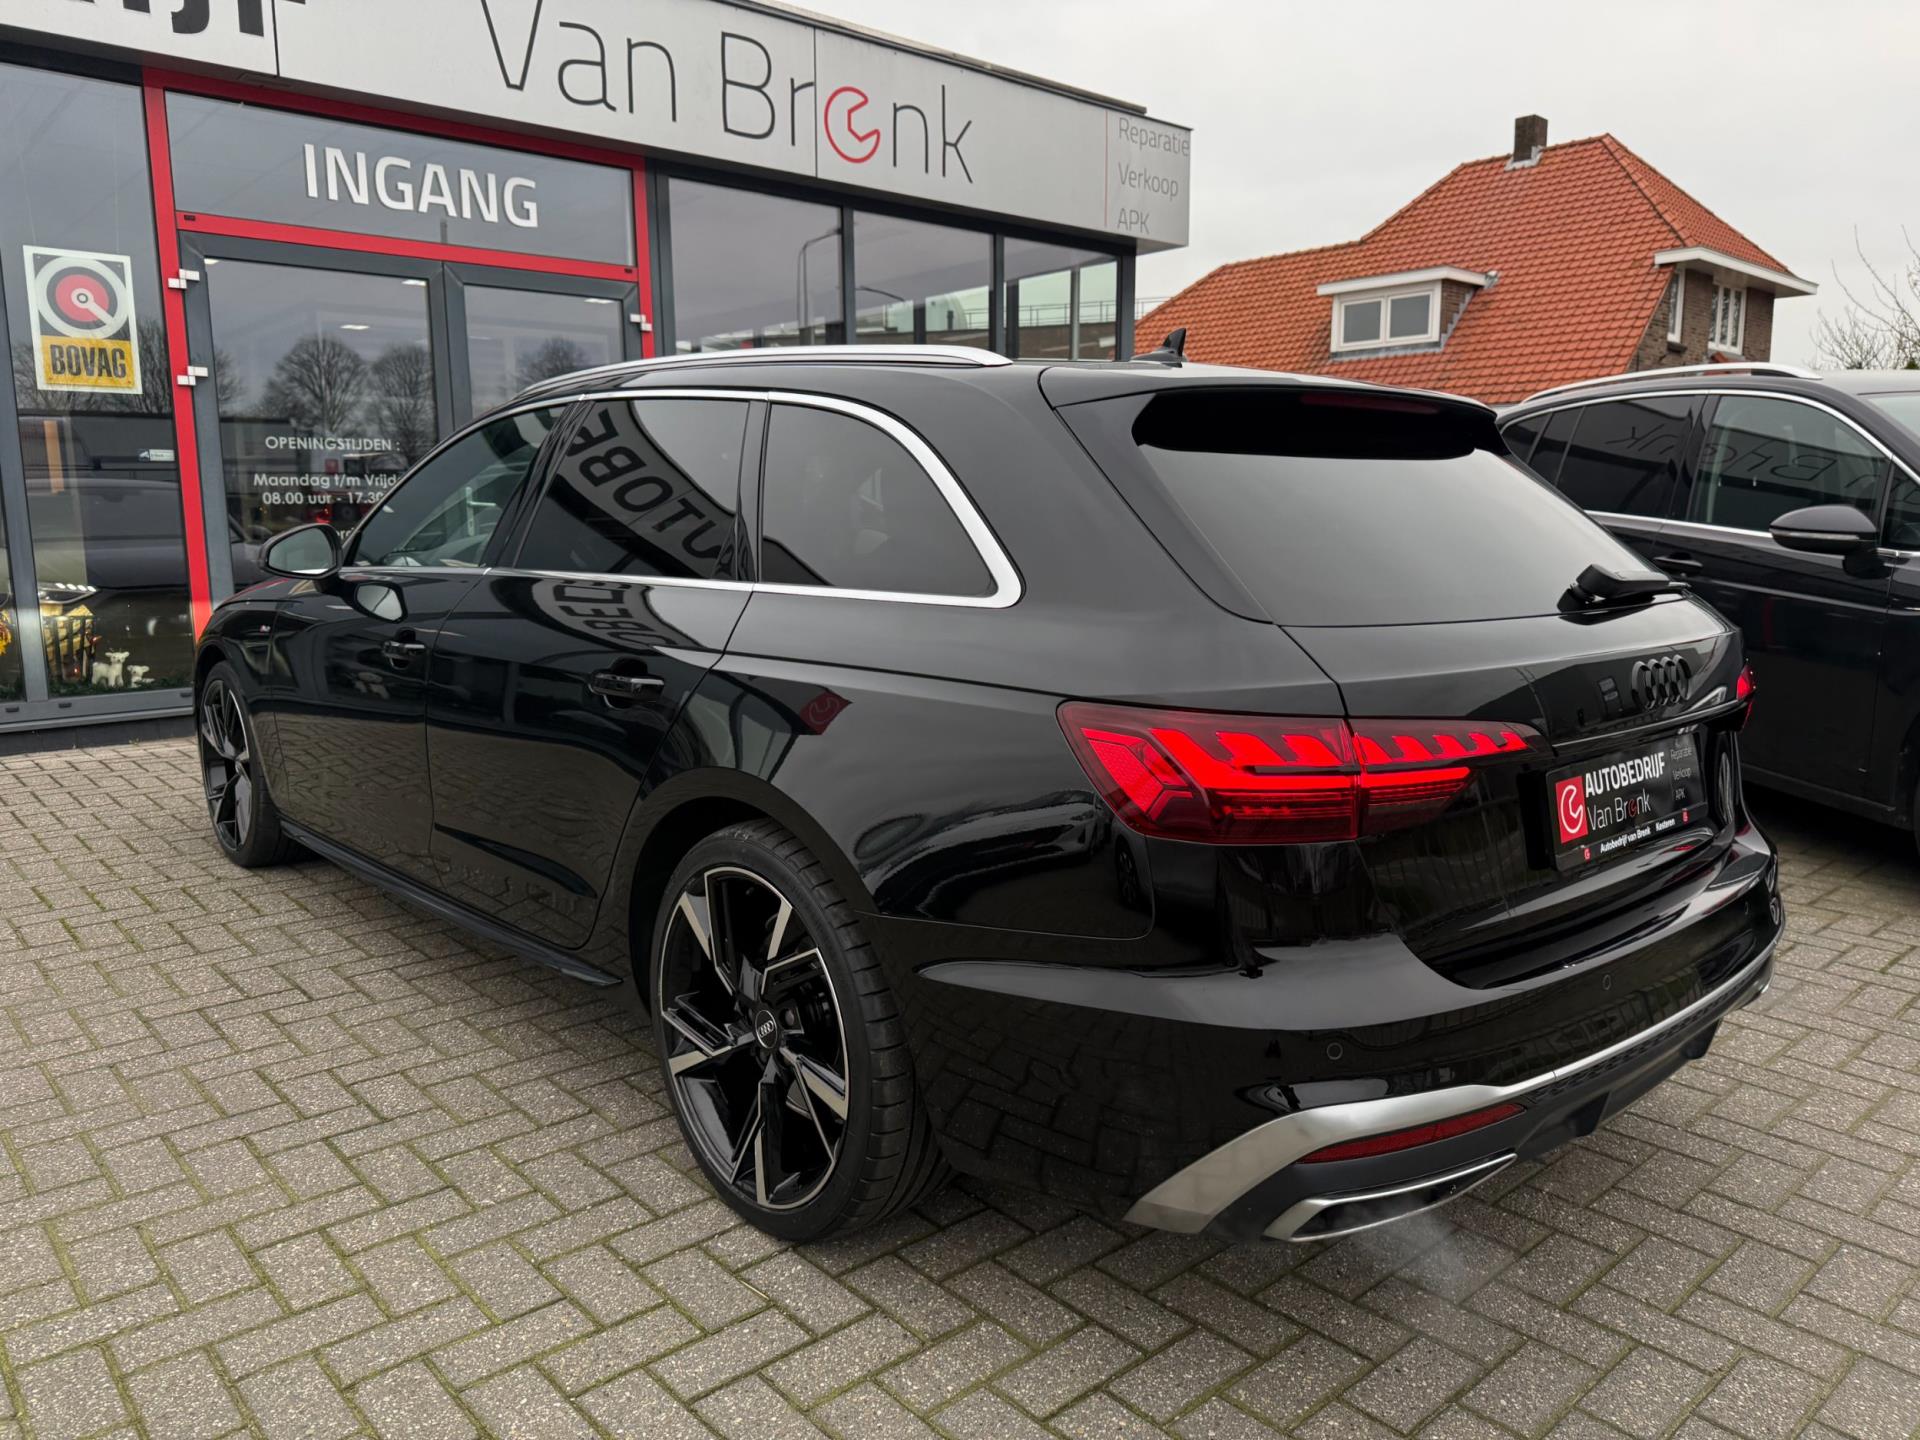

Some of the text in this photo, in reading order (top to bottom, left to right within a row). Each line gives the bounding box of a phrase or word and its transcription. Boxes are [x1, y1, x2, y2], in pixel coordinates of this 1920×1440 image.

[481, 0, 677, 122] Van
[1119, 117, 1190, 157] Reparatie
[304, 144, 539, 229] INGANG
[1118, 162, 1179, 202] Verkoop
[1117, 207, 1150, 235] APK
[50, 344, 127, 378] BOVAG
[265, 436, 392, 451] OPENINGSTIJDEN
[253, 473, 330, 488] Maandag
[334, 474, 361, 488] t/m
[262, 492, 304, 505] 08.00
[308, 493, 332, 504] uur
[1585, 752, 1665, 798] AUTOBEDRIJF
[1587, 804, 1613, 831] Van
